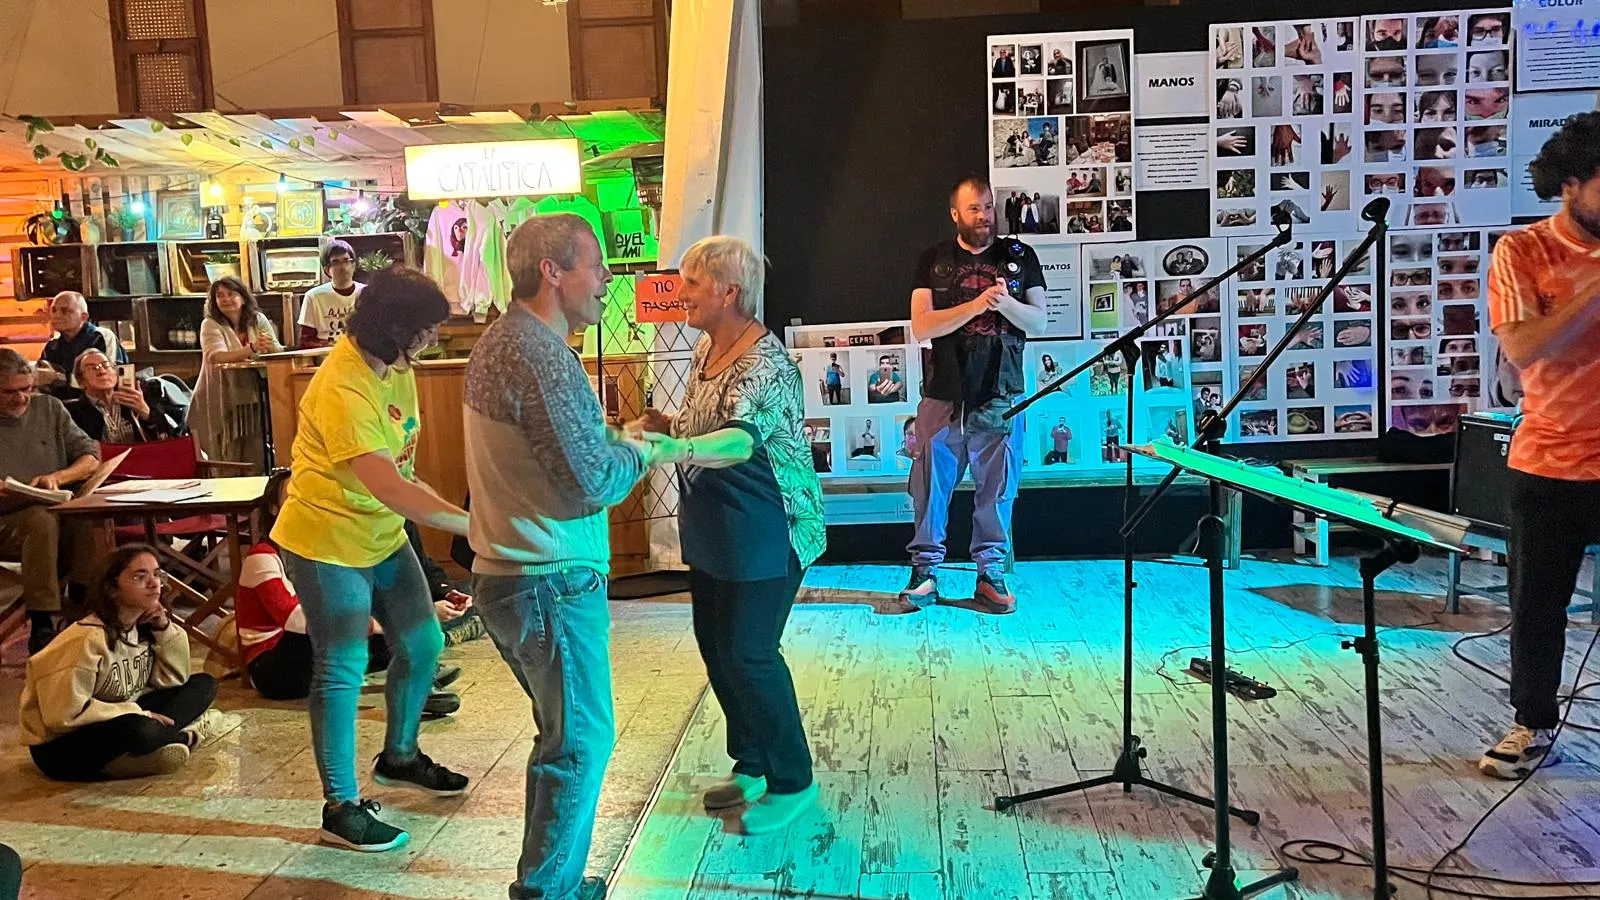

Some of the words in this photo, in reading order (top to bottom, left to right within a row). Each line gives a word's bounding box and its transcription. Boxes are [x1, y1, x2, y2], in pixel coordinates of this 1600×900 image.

[1148, 76, 1195, 88] MANOS
[1528, 118, 1567, 128] MIRAD
[1040, 263, 1071, 271] TRATOS
